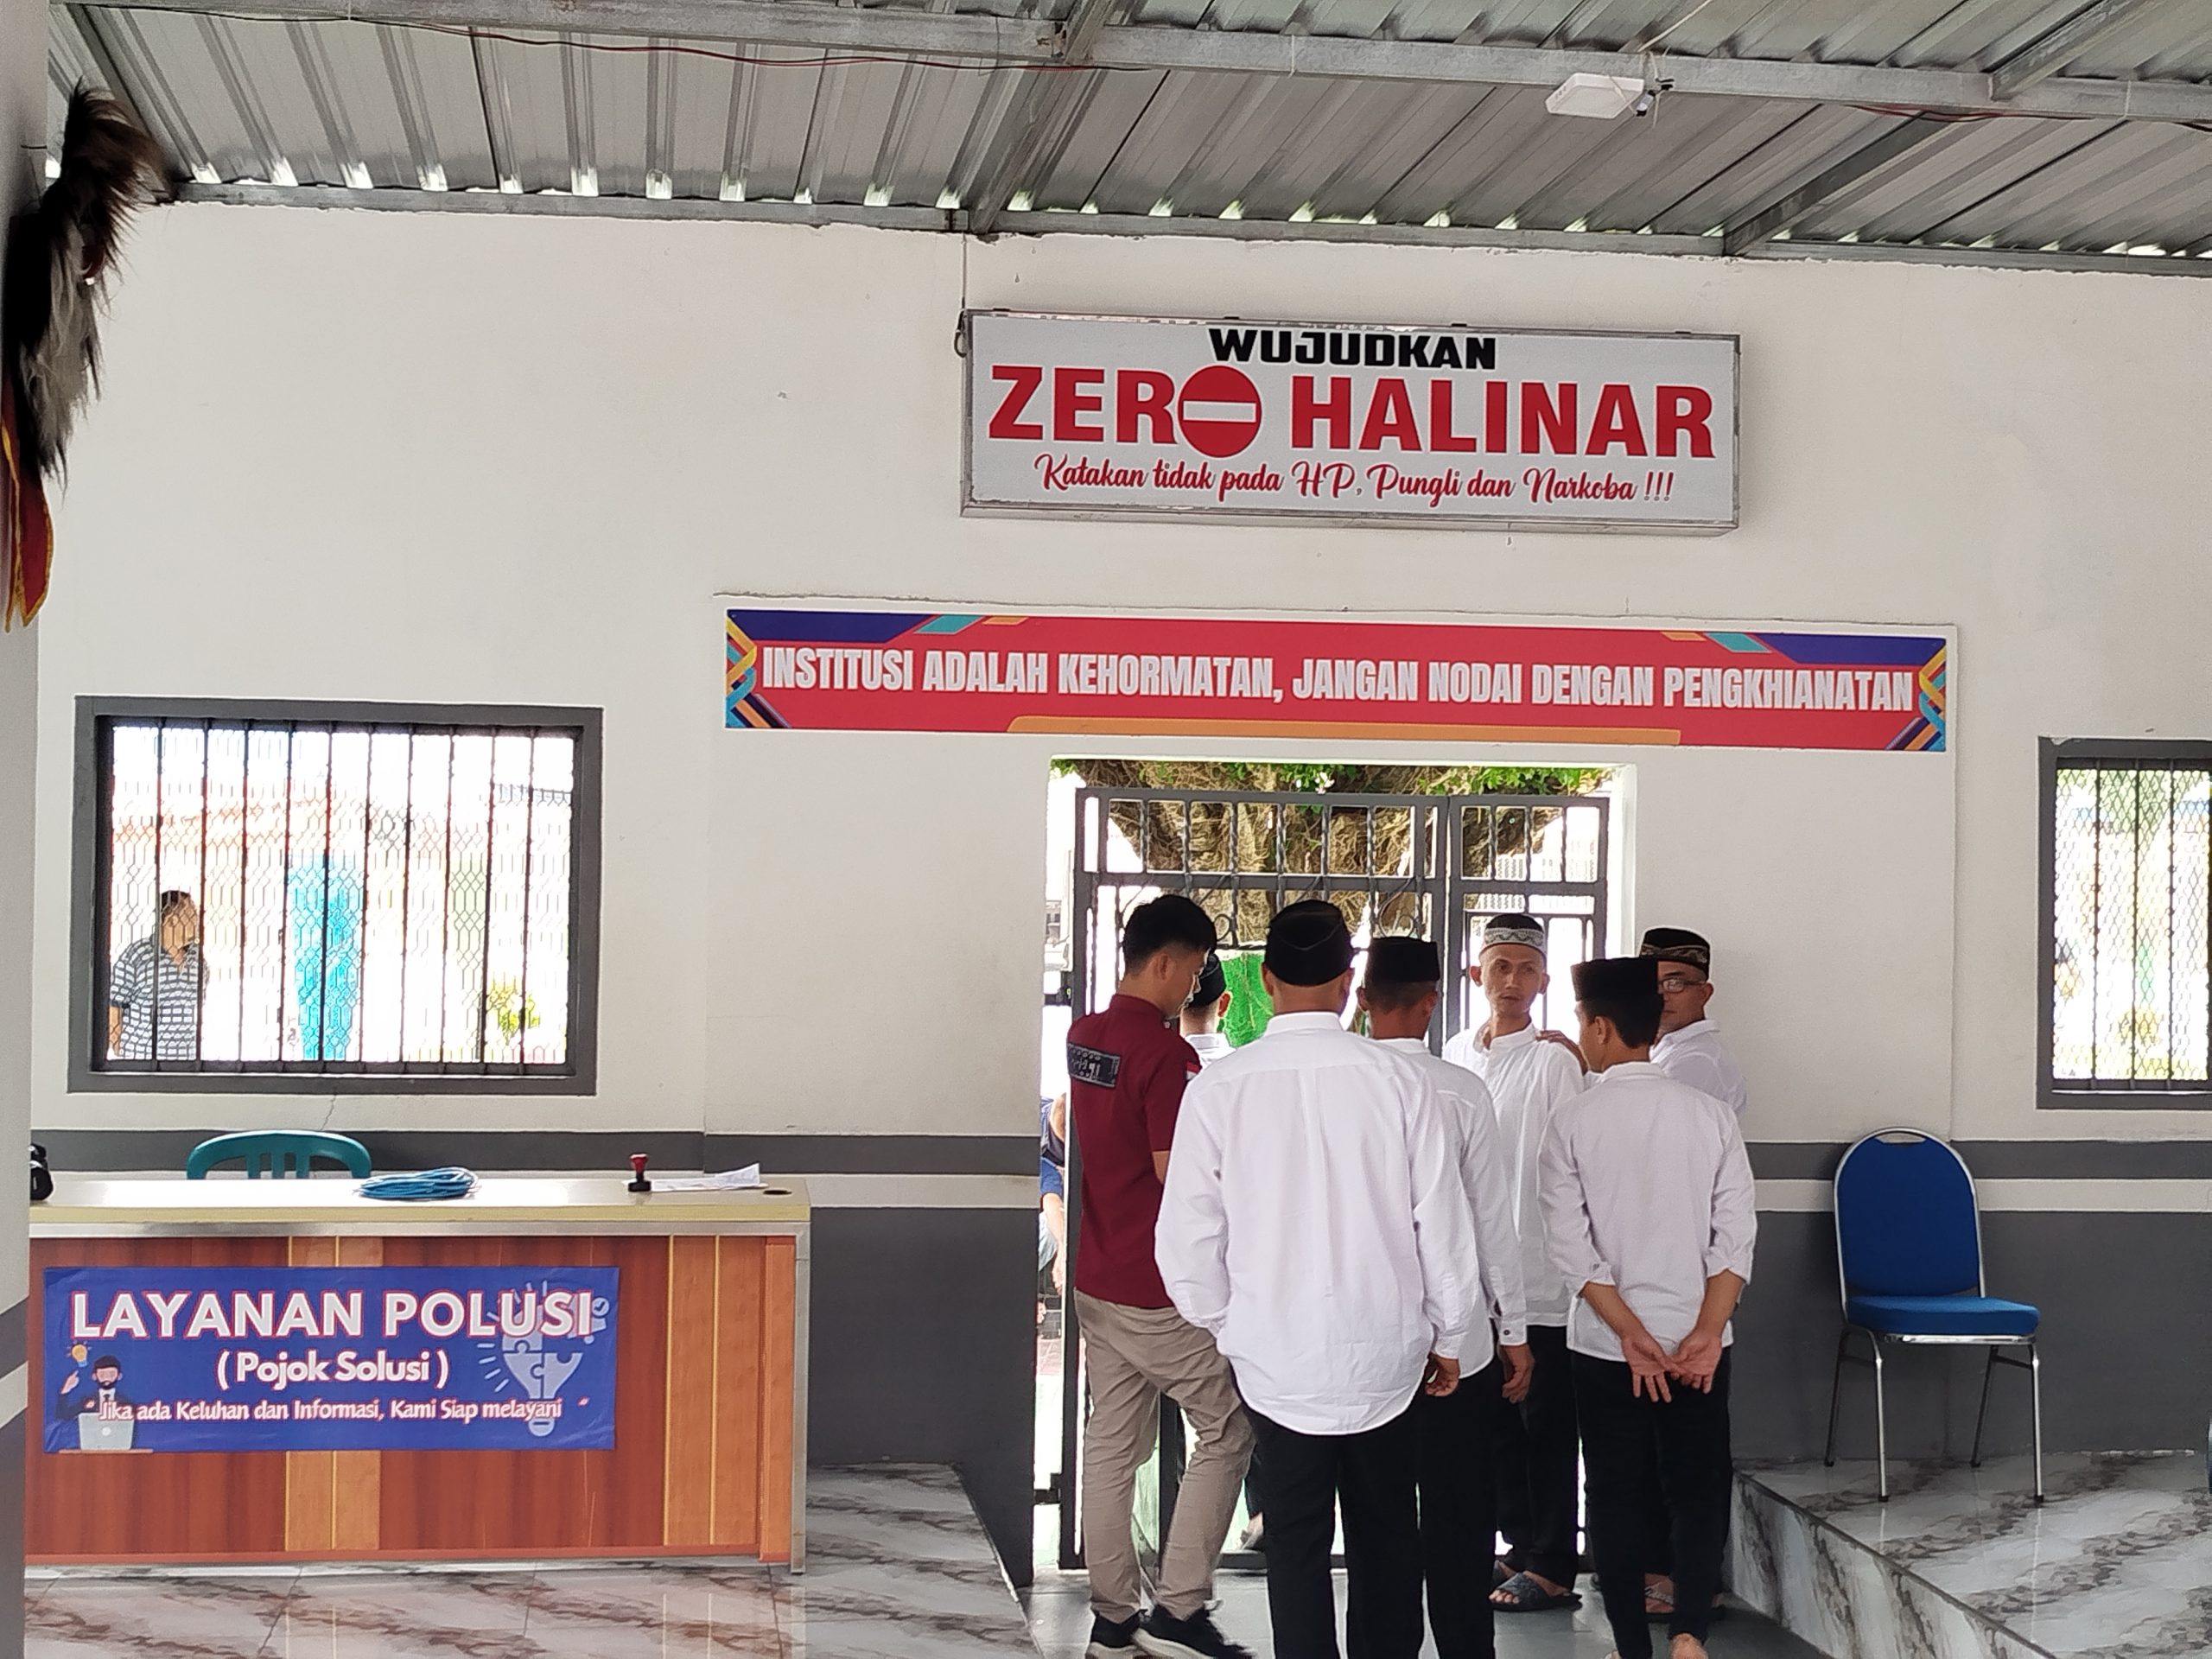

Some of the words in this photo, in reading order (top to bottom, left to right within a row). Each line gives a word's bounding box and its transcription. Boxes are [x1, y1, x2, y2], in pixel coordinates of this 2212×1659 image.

[1209, 327, 1497, 370] WUJUDKAN
[1291, 375, 1716, 459] HALINAR
[1034, 454, 1147, 491] Katakan
[1153, 457, 1215, 489] tidak
[1218, 463, 1284, 502] pada
[1366, 463, 1463, 508] Pungli
[1466, 469, 1515, 499] dan
[1522, 467, 1637, 503] Narkoba
[762, 646, 914, 690] INSTITUSI
[922, 651, 1048, 693] ADALAH
[1058, 655, 1284, 703] KEHORMATAN,
[1292, 658, 1418, 702] JANGAN
[1427, 661, 1522, 703] NODAI
[1531, 664, 1654, 707] DENGAN
[1663, 667, 1913, 711] PENGKHIANATAN
[71, 1289, 364, 1338] LAYANAN
[384, 1289, 594, 1338] POLUSI
[136, 1399, 172, 1421] ada
[175, 1400, 250, 1421] Keluhan
[253, 1398, 289, 1421] dan
[294, 1396, 385, 1421] Informasi,
[391, 1397, 436, 1420] Kami
[440, 1397, 479, 1425] Siap
[481, 1397, 563, 1421] melayani
